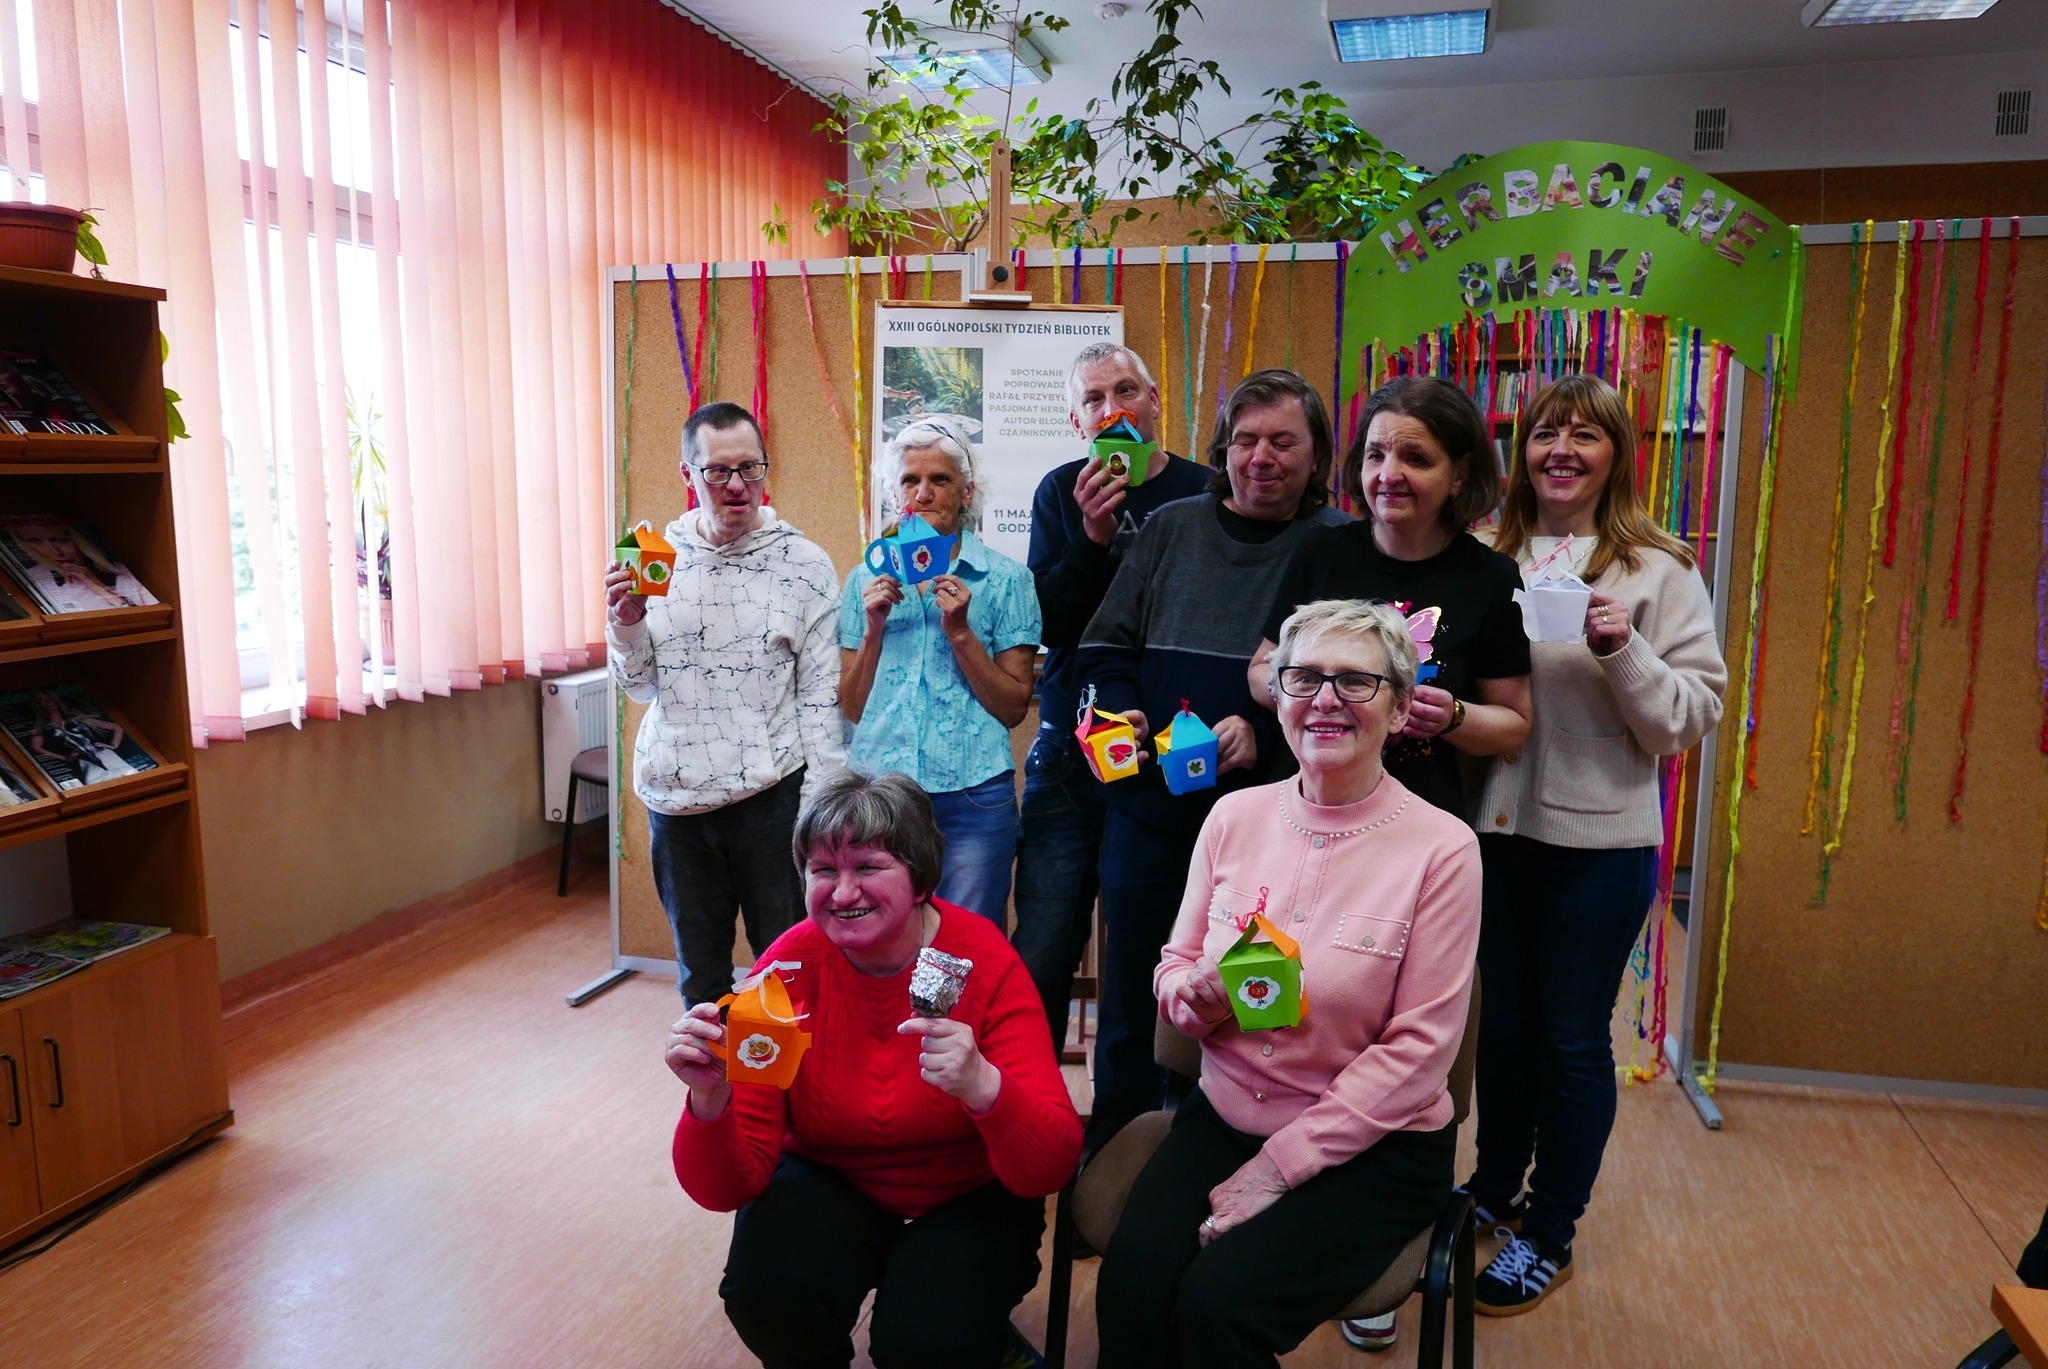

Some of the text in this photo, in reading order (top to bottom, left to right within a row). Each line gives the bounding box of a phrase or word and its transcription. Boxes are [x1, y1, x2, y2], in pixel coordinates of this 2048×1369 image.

[1380, 161, 1770, 274] HERBACIANE
[1458, 247, 1653, 308] SMAKI
[888, 319, 1111, 336] XXIII OGÓLNOPOLSKI TYDZIEŃ BIBLIOTEK
[1010, 368, 1064, 377] SPOTKANIE
[1004, 380, 1066, 389] POPROWADZ
[988, 391, 1067, 402] RAFAŁ PRZYBYL
[989, 404, 1039, 413] PASJONAT
[1003, 416, 1071, 425] AUTOR BLOGA
[999, 428, 1076, 438] CZAJNIKOWY.PL
[993, 508, 1033, 519] 11 MAJ
[997, 523, 1032, 533] GODZ
